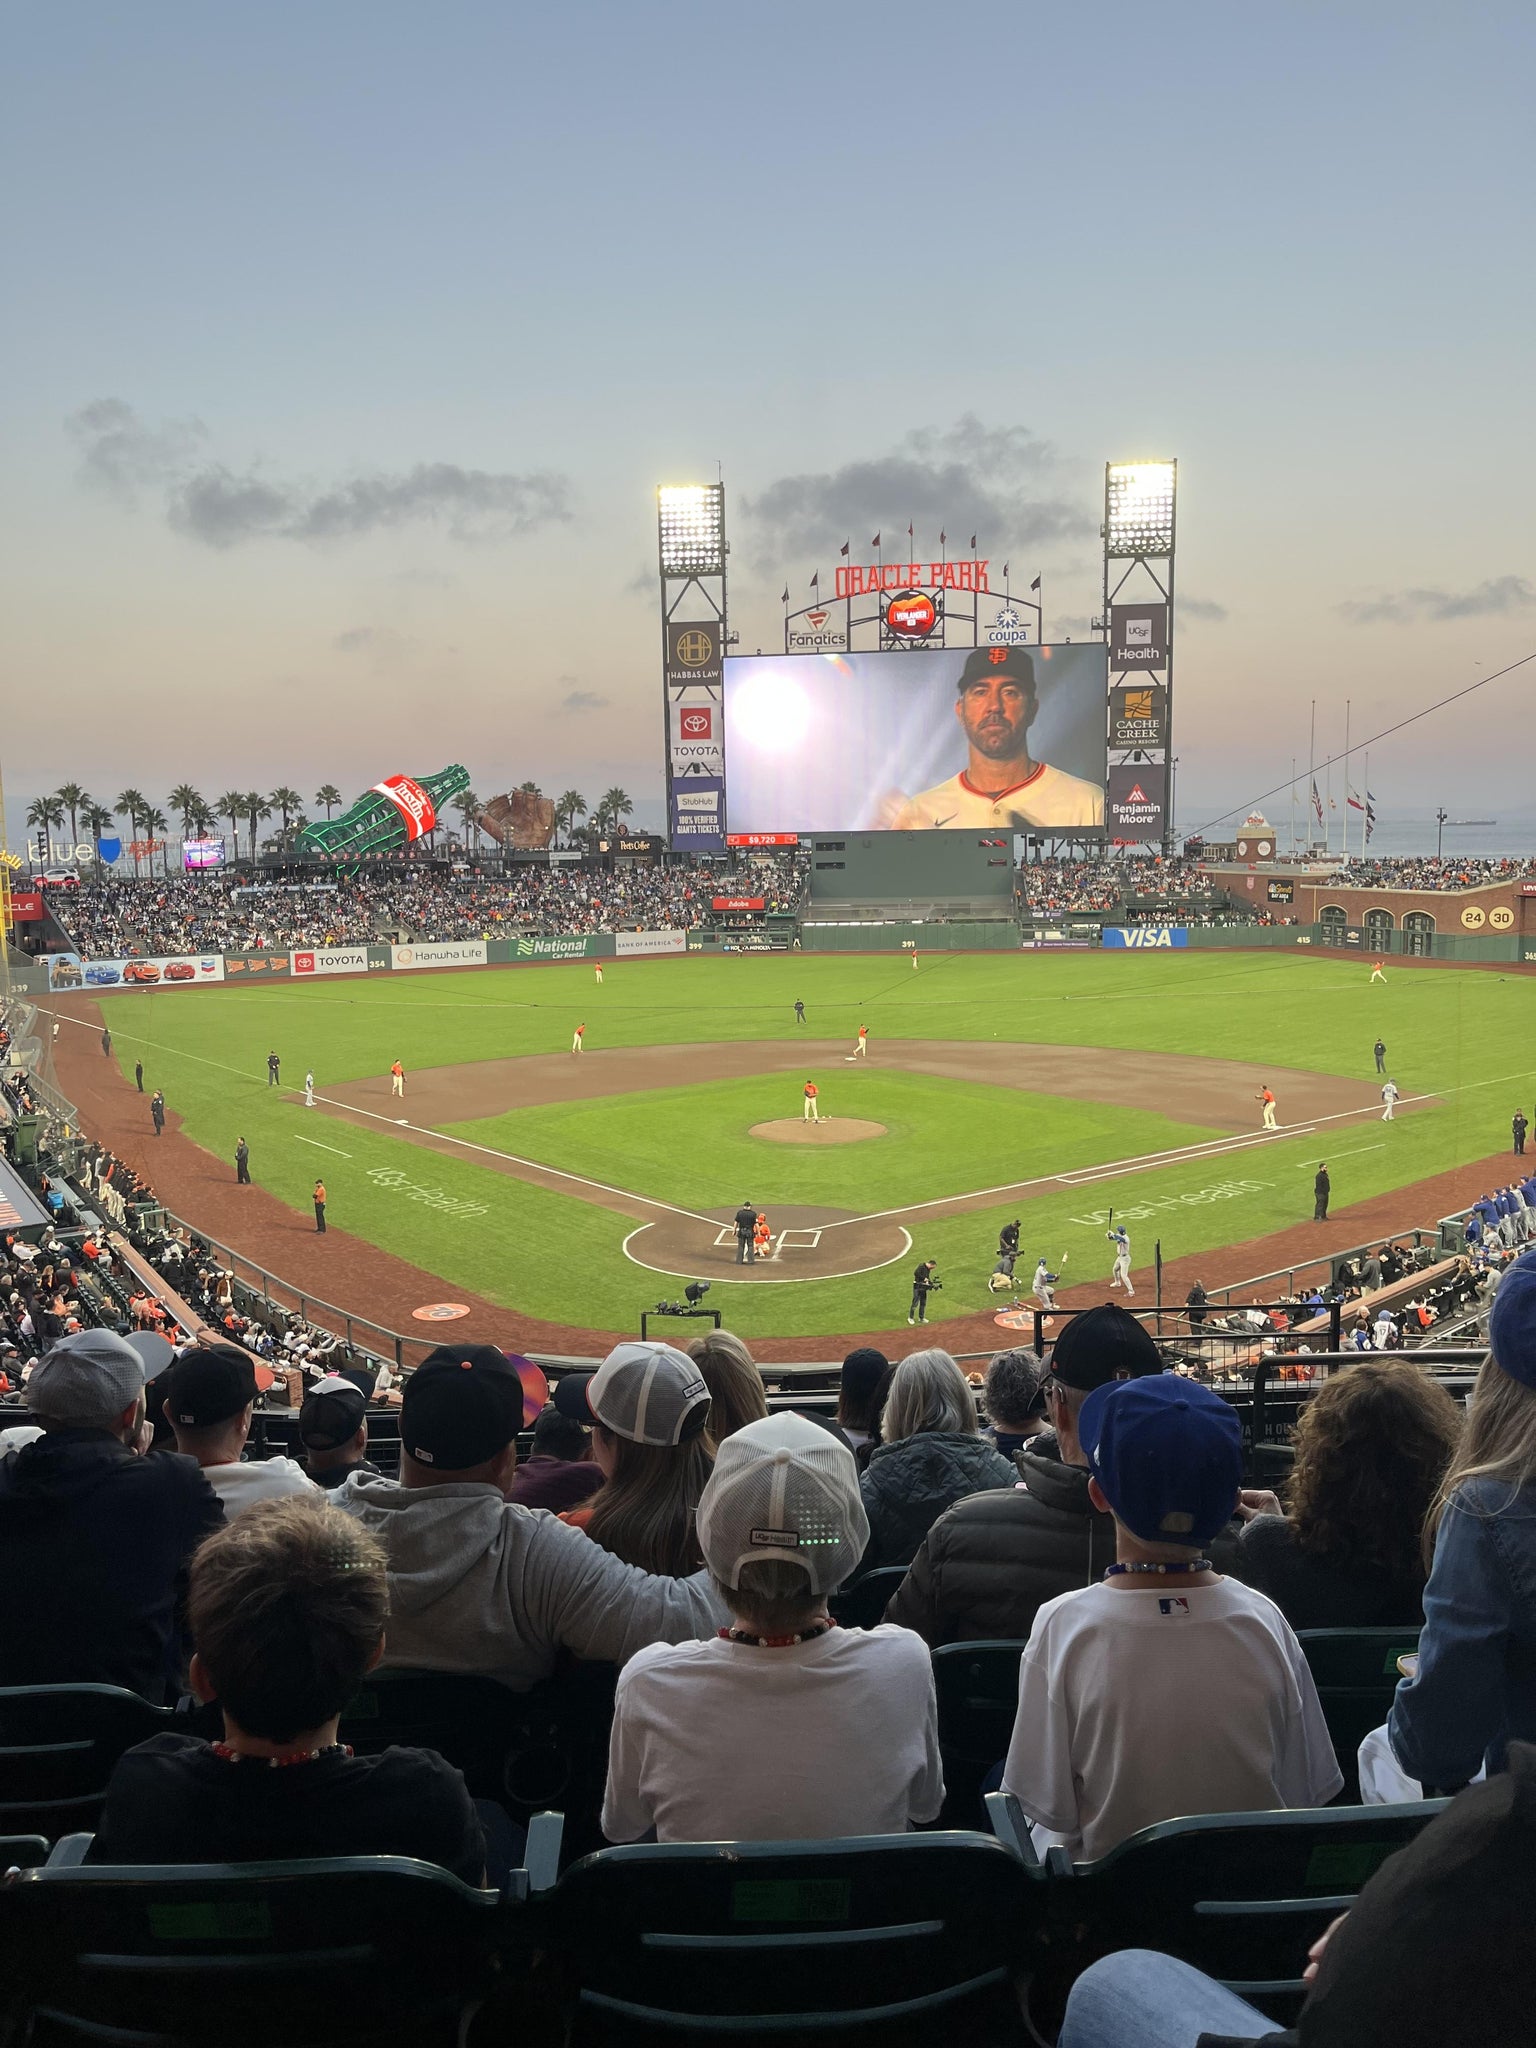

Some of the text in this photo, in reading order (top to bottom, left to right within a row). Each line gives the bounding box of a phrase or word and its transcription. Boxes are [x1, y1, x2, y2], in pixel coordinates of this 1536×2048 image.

[835, 560, 990, 599] ORACLE PARK
[1128, 626, 1149, 637] UCSF
[789, 631, 846, 646] Fanatics
[988, 631, 1027, 644] coupa
[1117, 647, 1160, 660] Health
[670, 670, 719, 680] HABBAS LAW
[1116, 720, 1160, 729] CACHE
[1117, 729, 1158, 739] CREEK
[673, 746, 719, 756] TOYOTA
[681, 797, 713, 806] StubHub
[1112, 802, 1161, 815] Benjamin
[678, 815, 718, 825] 100% VERIFIED
[677, 824, 720, 834] GIANTS TICKETS
[748, 836, 776, 845] $9,720
[28, 838, 94, 863] blue
[634, 840, 651, 852] Coffee
[1465, 913, 1482, 923] 24
[1493, 913, 1510, 923] 30
[1118, 929, 1172, 948] VISA
[1296, 936, 1311, 944] 415
[533, 938, 588, 954] National
[415, 949, 482, 961] Hanwha Life
[564, 951, 585, 959] Rental
[318, 955, 364, 966] TOYOTA
[368, 960, 386, 968] 354
[10, 984, 28, 993] 339
[392, 1183, 491, 1218] Health
[1140, 1180, 1277, 1211] Health
